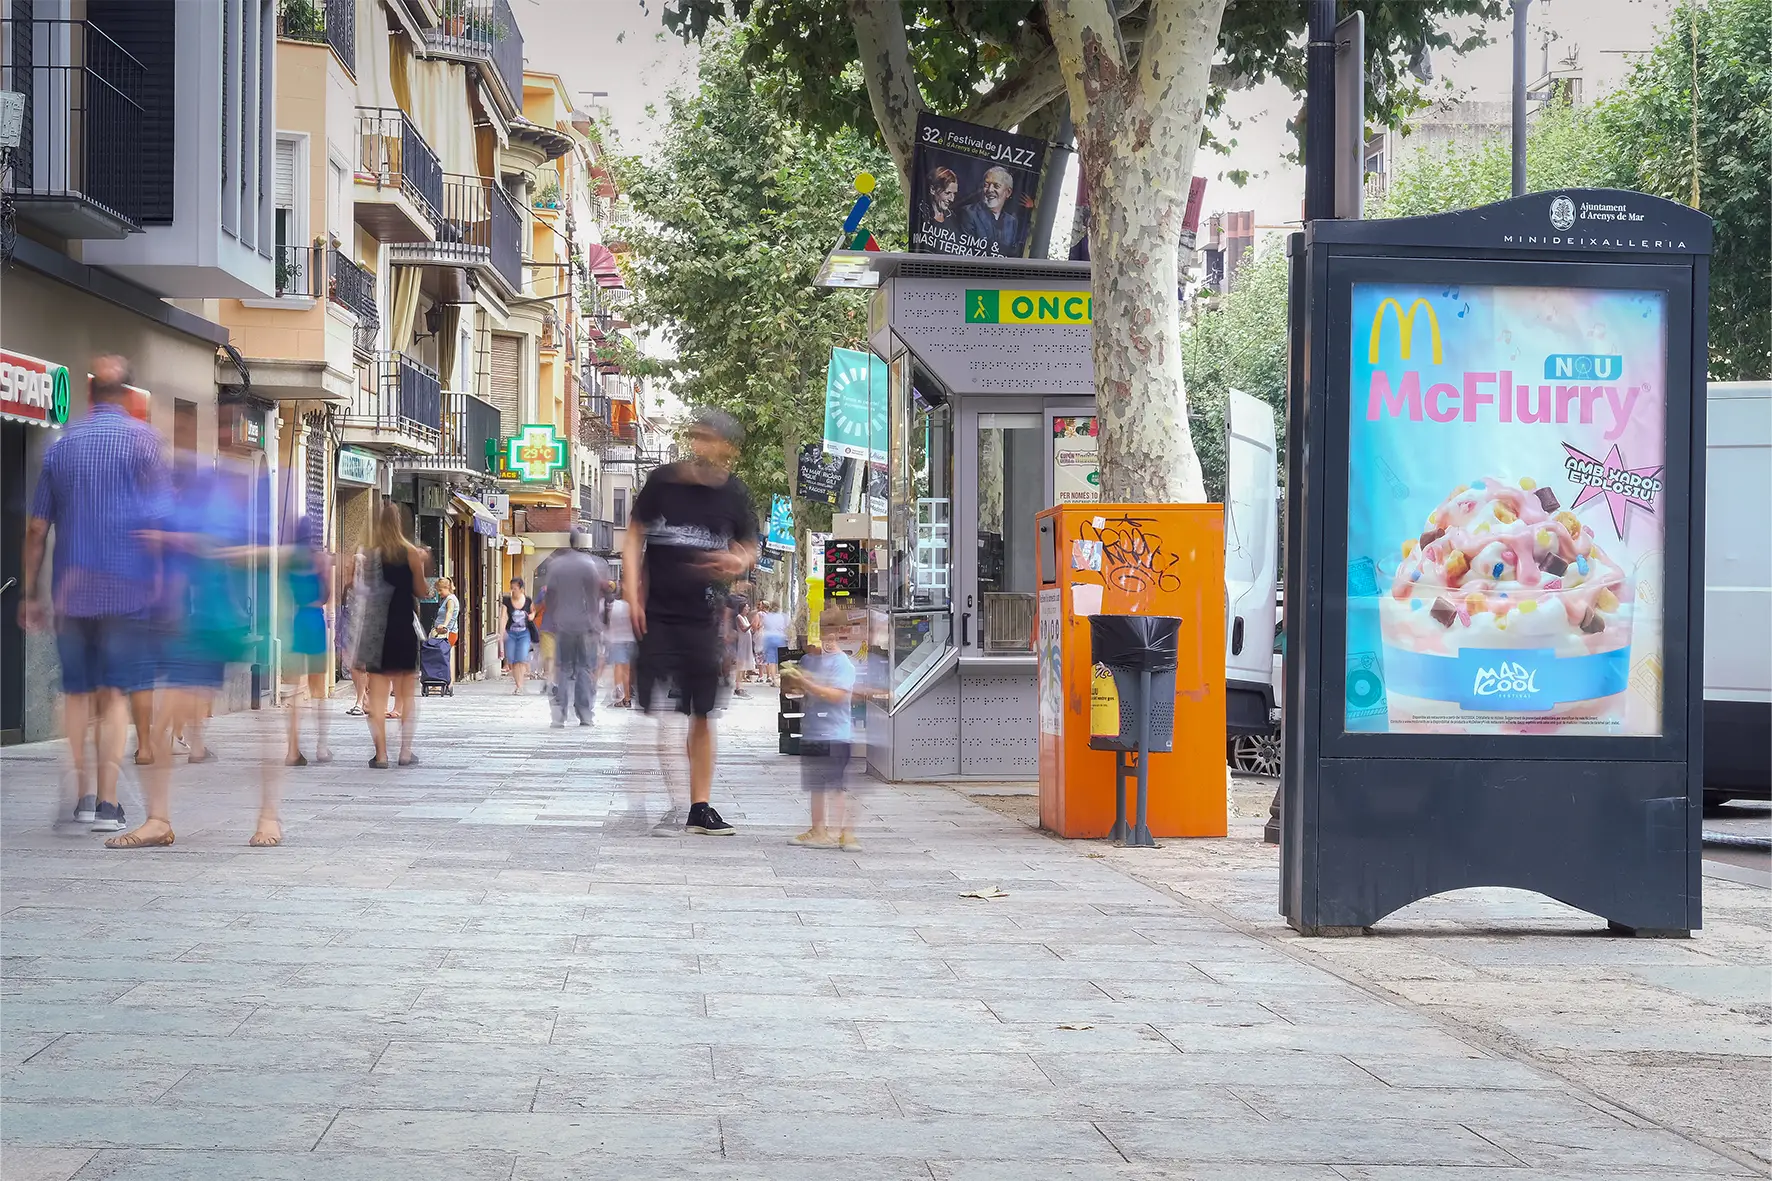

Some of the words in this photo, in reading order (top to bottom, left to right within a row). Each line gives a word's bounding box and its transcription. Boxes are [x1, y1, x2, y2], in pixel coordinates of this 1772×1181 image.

[947, 131, 984, 149] Festival
[985, 141, 997, 152] de
[990, 144, 1036, 167] JAZZ
[1580, 202, 1627, 213] Ajuntament
[1580, 211, 1616, 221] d'Arenys
[1617, 213, 1627, 221] de
[1628, 212, 1645, 222] Mar
[922, 221, 957, 243] LAURA
[960, 233, 988, 250] SIMÓ
[991, 241, 1000, 253] &
[1504, 235, 1687, 249] MINIDEIXALLERIA
[0, 362, 53, 410] SPAR
[1565, 456, 1604, 478] AMB
[1071, 491, 1089, 499] NOMÉS
[1474, 661, 1529, 695] MAD
[1478, 668, 1540, 695] COOL
